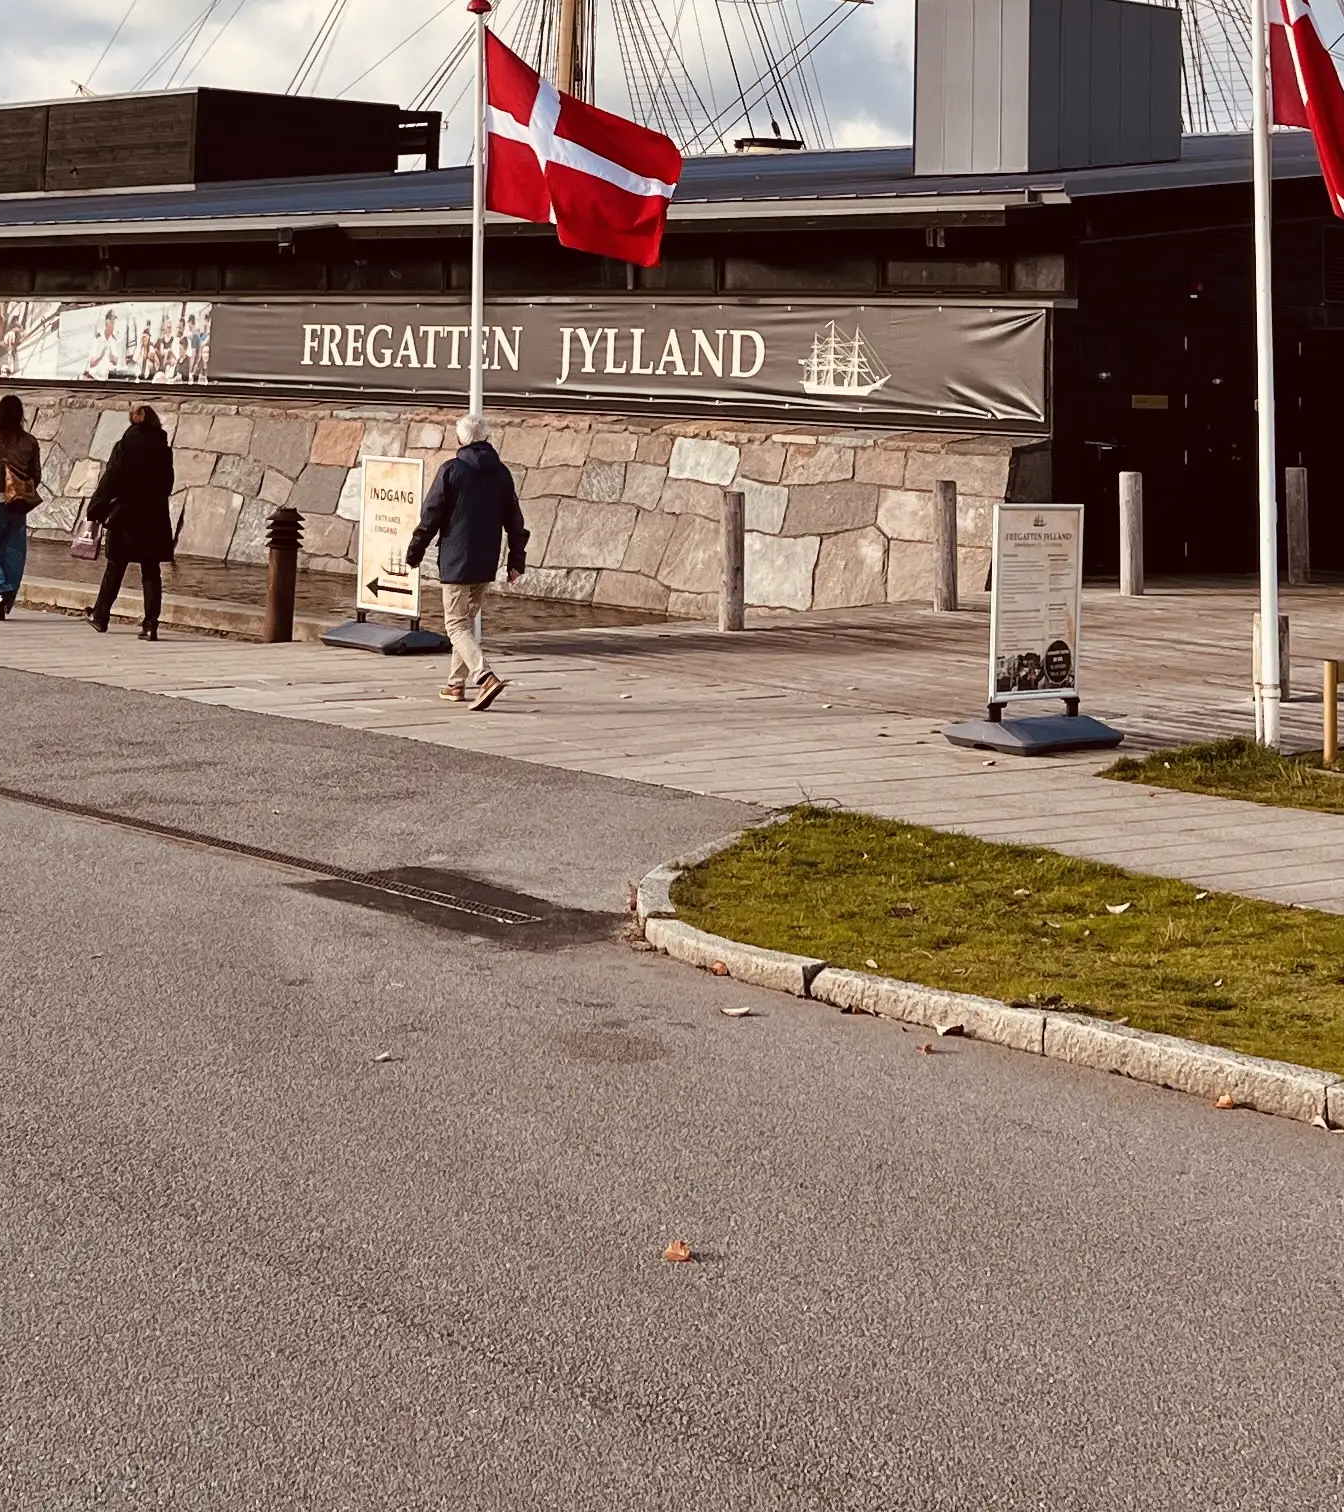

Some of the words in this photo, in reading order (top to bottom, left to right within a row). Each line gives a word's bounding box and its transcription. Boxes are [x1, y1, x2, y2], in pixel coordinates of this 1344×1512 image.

[556, 327, 766, 386] JYLLAND
[370, 487, 414, 504] INDGANG
[1005, 532, 1042, 541] FREGATTEN
[1043, 532, 1073, 542] JYLLAND
